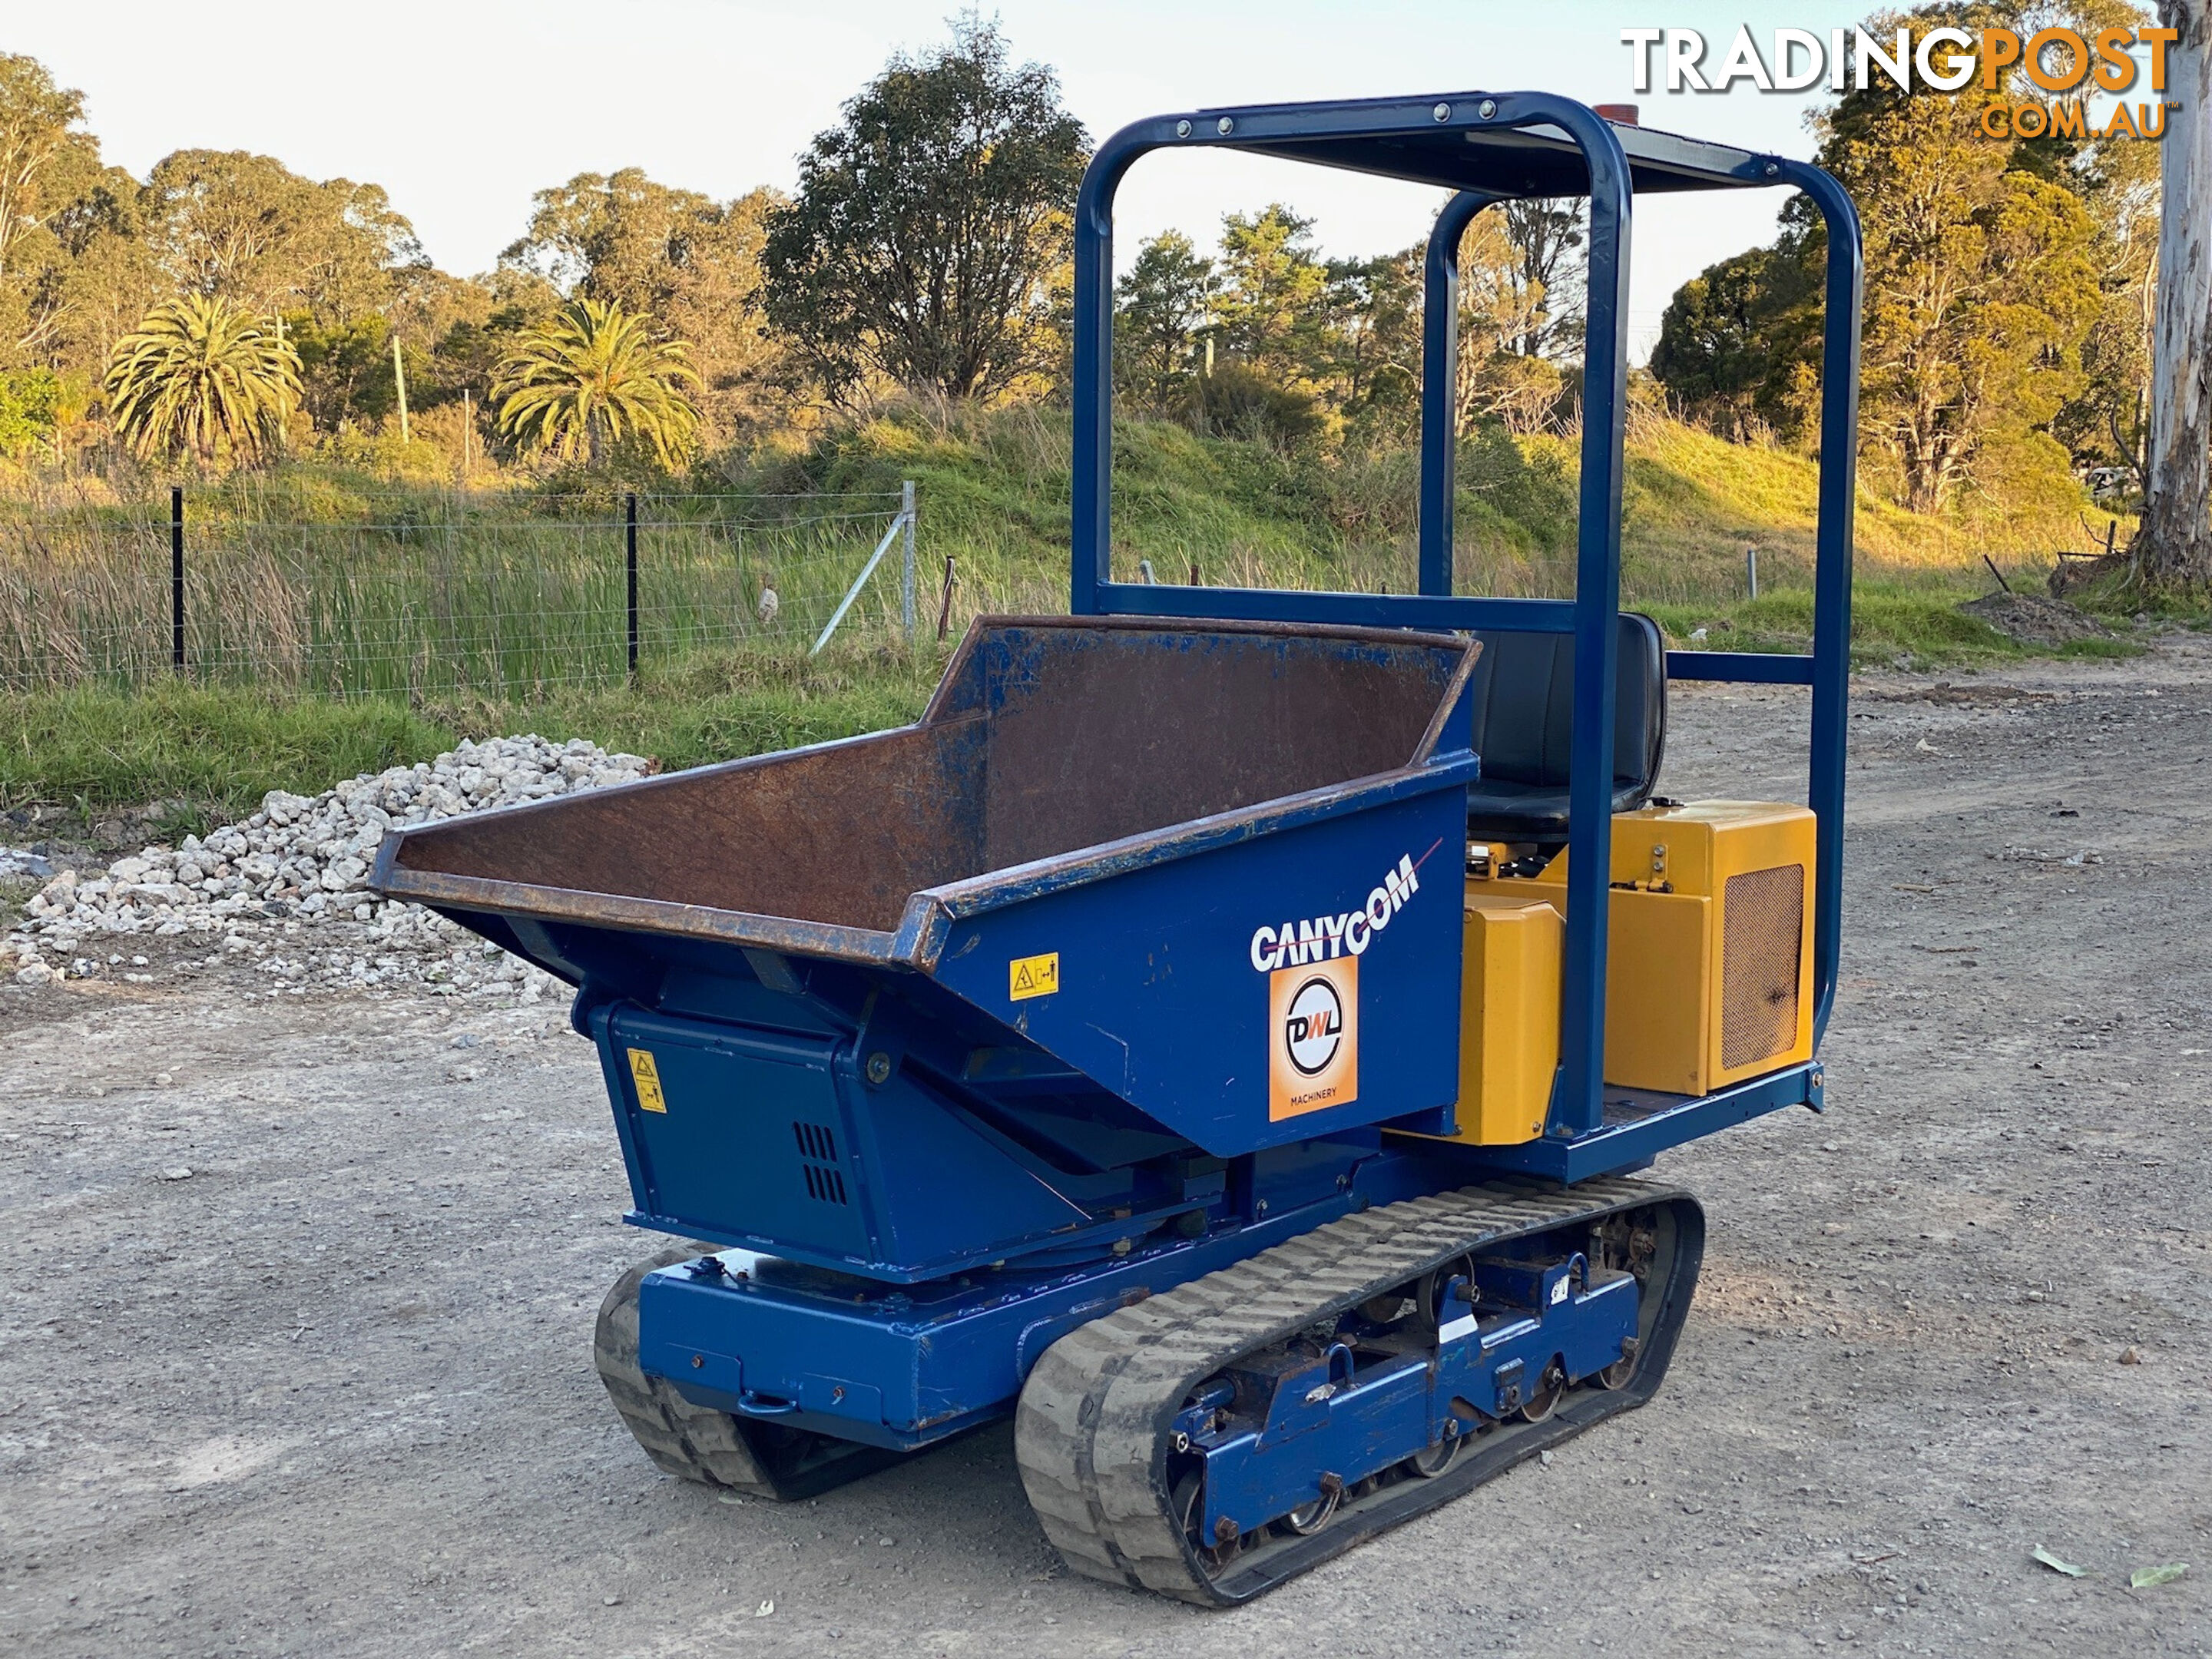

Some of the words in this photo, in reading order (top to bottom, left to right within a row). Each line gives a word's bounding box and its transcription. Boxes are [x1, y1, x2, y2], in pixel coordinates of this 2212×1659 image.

[1250, 853, 1419, 972] CANYCOM
[1286, 1009, 1342, 1043] DWL
[1290, 1087, 1337, 1107] MACHINERY
